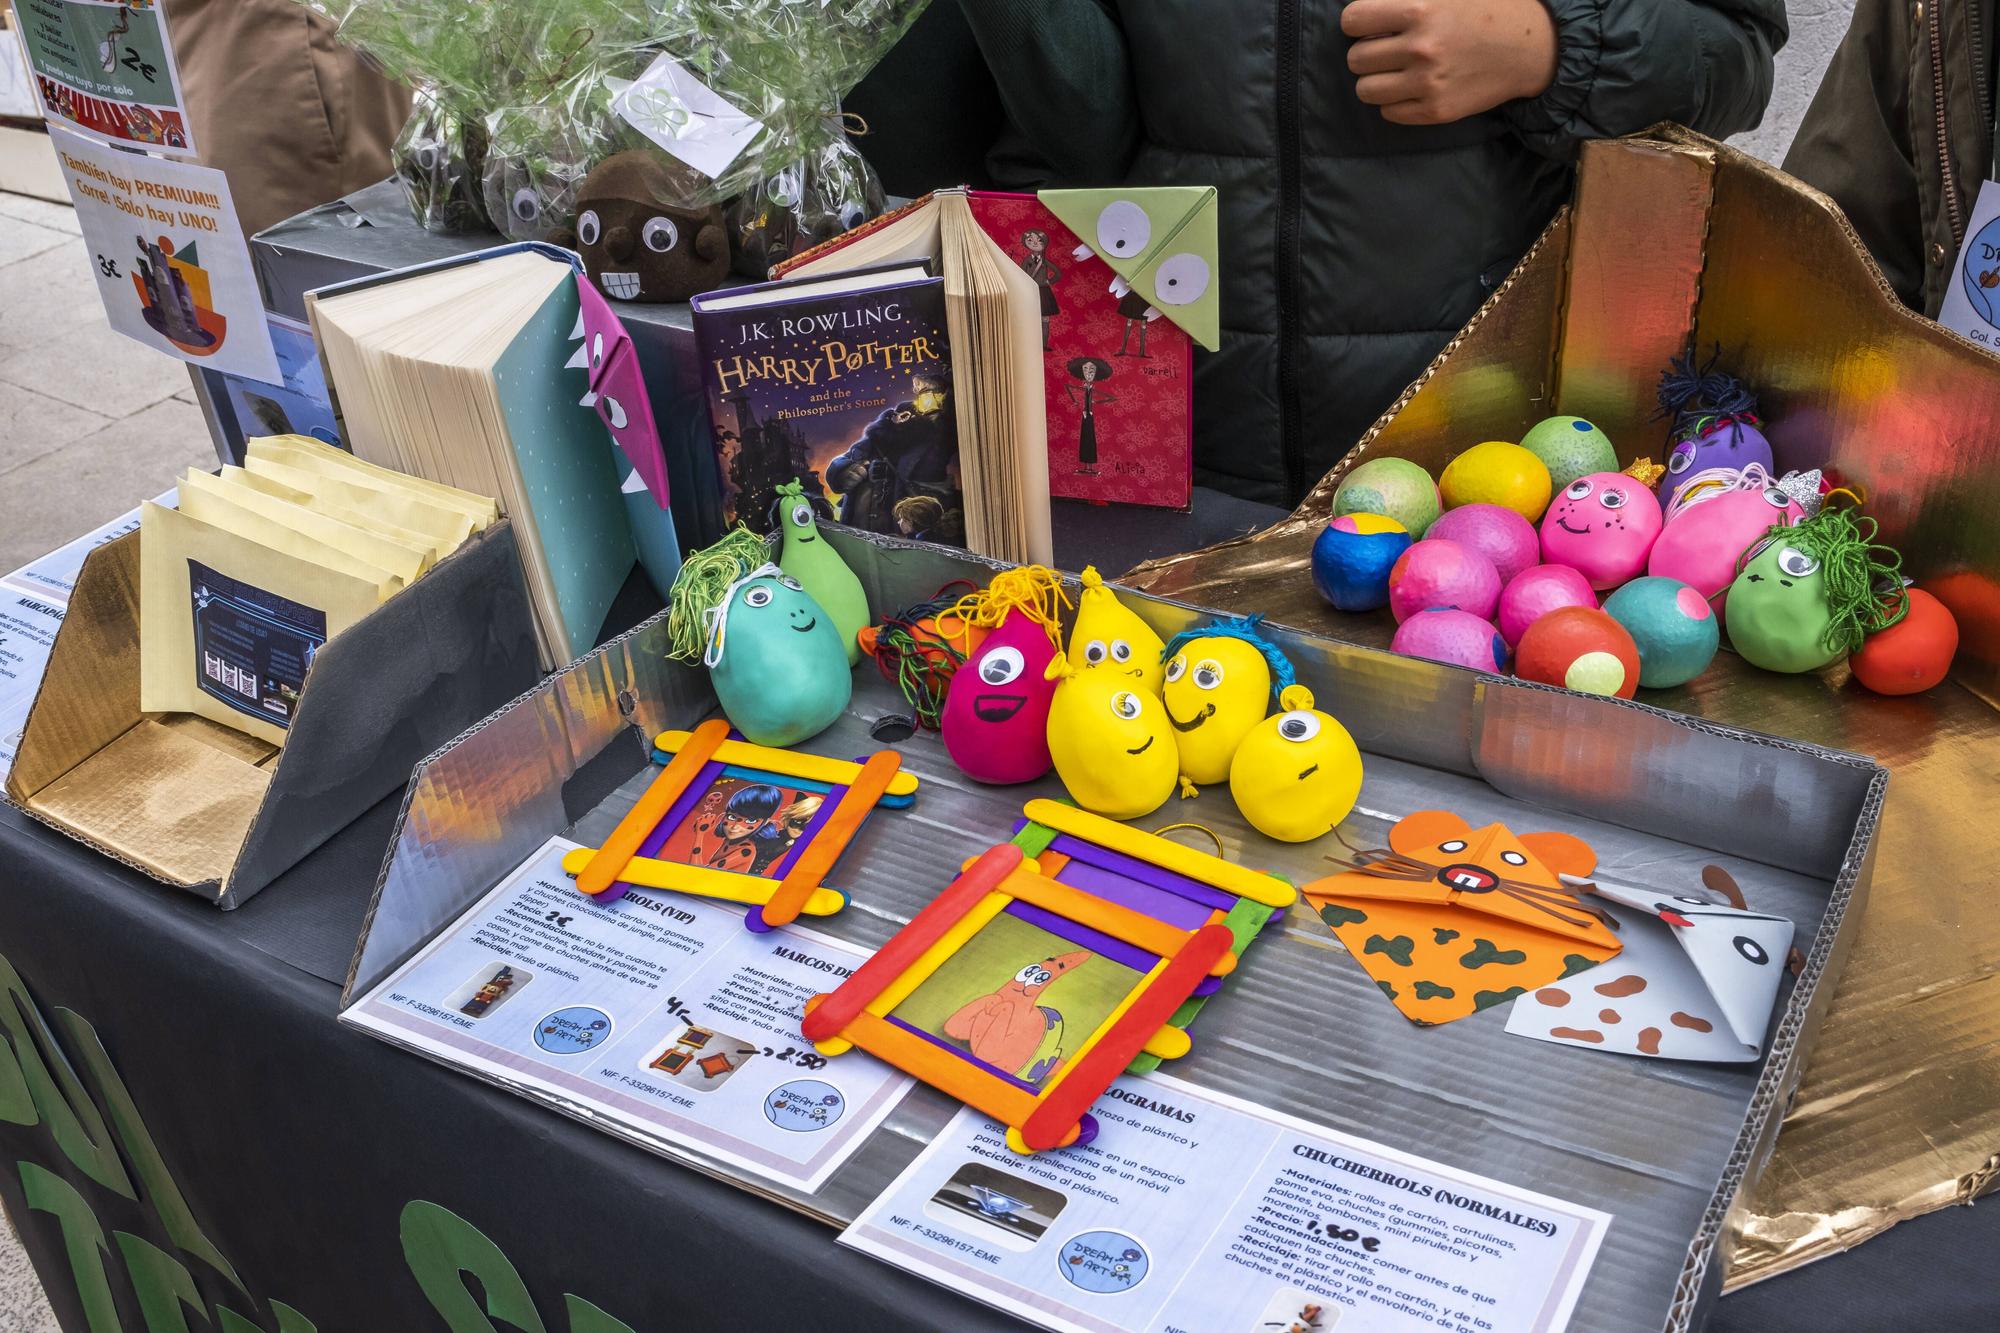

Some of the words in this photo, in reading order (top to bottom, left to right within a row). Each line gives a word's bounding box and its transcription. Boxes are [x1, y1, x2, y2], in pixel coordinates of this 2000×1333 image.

[96, 80, 111, 93] por
[113, 84, 134, 97] solo
[60, 152, 109, 185] También
[108, 171, 132, 195] hay
[134, 179, 221, 210] PREMIUM!!!
[76, 178, 111, 205] Corre!
[148, 207, 175, 227] hay
[178, 211, 218, 233] UNO!
[739, 322, 775, 345] J.K.
[781, 303, 902, 337] ROWLING
[1970, 329, 1990, 344] Col.
[713, 354, 823, 395] HARRY
[820, 335, 940, 381] POTTER
[777, 399, 853, 420] Philosopher's
[854, 396, 887, 409] Stone
[809, 390, 831, 402] and
[833, 388, 851, 400] the
[511, 901, 545, 916] -Precio:
[518, 893, 549, 908] dipper)
[536, 880, 586, 903] -Materiales:
[607, 906, 619, 916] de
[619, 909, 647, 926] cartón
[647, 921, 663, 933] con
[664, 927, 704, 948] gomaeva,
[660, 906, 696, 925] (VIP)
[476, 928, 510, 945] pongan
[533, 887, 566, 905] chuches
[566, 901, 617, 925] (chocolatina
[618, 920, 628, 930] de
[628, 924, 656, 941] jungle,
[656, 935, 690, 953] piruleta
[470, 935, 515, 957] -Reciclaje:
[544, 963, 580, 982] plástico.
[494, 914, 521, 929] comas
[521, 924, 534, 934] las
[534, 929, 569, 947] chuches,
[570, 943, 606, 963] quédate
[613, 958, 638, 975] ponle
[637, 967, 662, 981] otras
[503, 907, 584, 941] -Recomendaciones:
[584, 937, 596, 947] no
[605, 944, 624, 957] tires
[624, 952, 657, 970] cuando
[656, 964, 668, 973] te
[519, 934, 543, 948] come
[542, 941, 556, 952] las
[556, 947, 589, 965] chuches
[616, 970, 629, 980] de
[629, 976, 648, 990] que
[648, 981, 658, 990] se
[740, 965, 796, 988] -Materiales:
[772, 945, 835, 973] MARCOS
[726, 980, 761, 996] -Precio:
[732, 972, 765, 988] colores,
[767, 985, 794, 1000] goma
[388, 993, 407, 1004] NIF:
[406, 999, 476, 1029] F-33296157-EME
[551, 1016, 584, 1032] DREAM
[702, 1002, 750, 1023] -Reciclaje:
[750, 1018, 773, 1031] todo
[773, 1026, 785, 1035] al
[709, 993, 730, 1006] sitio
[730, 1001, 747, 1011] con
[747, 1006, 777, 1023] altura.
[555, 1029, 576, 1041] ART
[600, 1068, 620, 1081] NIF:
[619, 1076, 696, 1109] F-33296157-EME
[778, 1089, 815, 1107] DREAM
[1102, 1085, 1196, 1124] LOGRAMAS
[785, 1104, 810, 1117] ART
[1095, 1108, 1125, 1123] trozo
[1125, 1116, 1142, 1128] de
[1142, 1124, 1190, 1146] plástico
[1190, 1140, 1200, 1150] y
[973, 1133, 1002, 1148] para
[965, 1142, 1026, 1170] -Reciclaje:
[1058, 1175, 1073, 1187] al
[1071, 1180, 1120, 1205] plástico.
[1058, 1149, 1101, 1169] encima
[1101, 1163, 1118, 1175] de
[1118, 1168, 1135, 1181] un
[1136, 1175, 1171, 1194] móvil
[1105, 1152, 1121, 1163] en
[1121, 1158, 1138, 1169] un
[1139, 1164, 1186, 1186] espacio
[1262, 1195, 1323, 1222] morenitos.
[1281, 1166, 1352, 1196] -Materiales:
[1354, 1190, 1386, 1208] rollos
[1388, 1201, 1405, 1214] de
[1406, 1208, 1450, 1230] cartón,
[1452, 1224, 1517, 1251] cartulinas,
[1292, 1144, 1434, 1197] CHUCHERROLS
[1434, 1189, 1557, 1238] (NORMALES)
[1256, 1204, 1304, 1226] -Precio:
[1267, 1185, 1313, 1207] palotes,
[1316, 1201, 1381, 1231] bombones,
[1383, 1225, 1411, 1240] mini
[1412, 1232, 1467, 1259] piruletas
[1469, 1253, 1479, 1264] y
[1274, 1176, 1309, 1194] goma
[1311, 1188, 1334, 1203] eva,
[1337, 1196, 1386, 1220] chuches
[1388, 1214, 1450, 1243] (gummies,
[1453, 1234, 1503, 1259] picotas,
[889, 1214, 912, 1229] NIF:
[912, 1223, 1002, 1266] F-33296157-EME
[1072, 1241, 1116, 1264] DREAM
[1244, 1223, 1303, 1251] caduquen
[1304, 1243, 1323, 1257] las
[1324, 1251, 1376, 1277] chuches.
[1083, 1259, 1110, 1276] ART
[1224, 1251, 1273, 1276] chuches
[1275, 1270, 1291, 1283] en
[1292, 1275, 1306, 1288] el
[1305, 1280, 1357, 1307] plastico.
[1250, 1214, 1371, 1262] -Recomendaciones:
[1372, 1256, 1413, 1276] comer
[1414, 1269, 1450, 1289] antes
[1451, 1284, 1470, 1296] de
[1471, 1291, 1497, 1307] que
[1231, 1241, 1279, 1266] chuches
[1281, 1260, 1294, 1271] el
[1293, 1265, 1343, 1289] plástico
[1344, 1284, 1355, 1295] y
[1355, 1287, 1368, 1299] el
[1370, 1293, 1434, 1323] envoltorio
[1436, 1316, 1454, 1330] de
[1237, 1233, 1302, 1262] -Reciclaje:
[1304, 1256, 1332, 1272] tirar
[1332, 1266, 1345, 1277] el
[1346, 1271, 1374, 1288] rollo
[1376, 1282, 1392, 1295] en
[1394, 1288, 1439, 1313] cartón,
[1442, 1306, 1452, 1317] y
[1453, 1310, 1471, 1323] de
[1474, 1316, 1493, 1331] las
